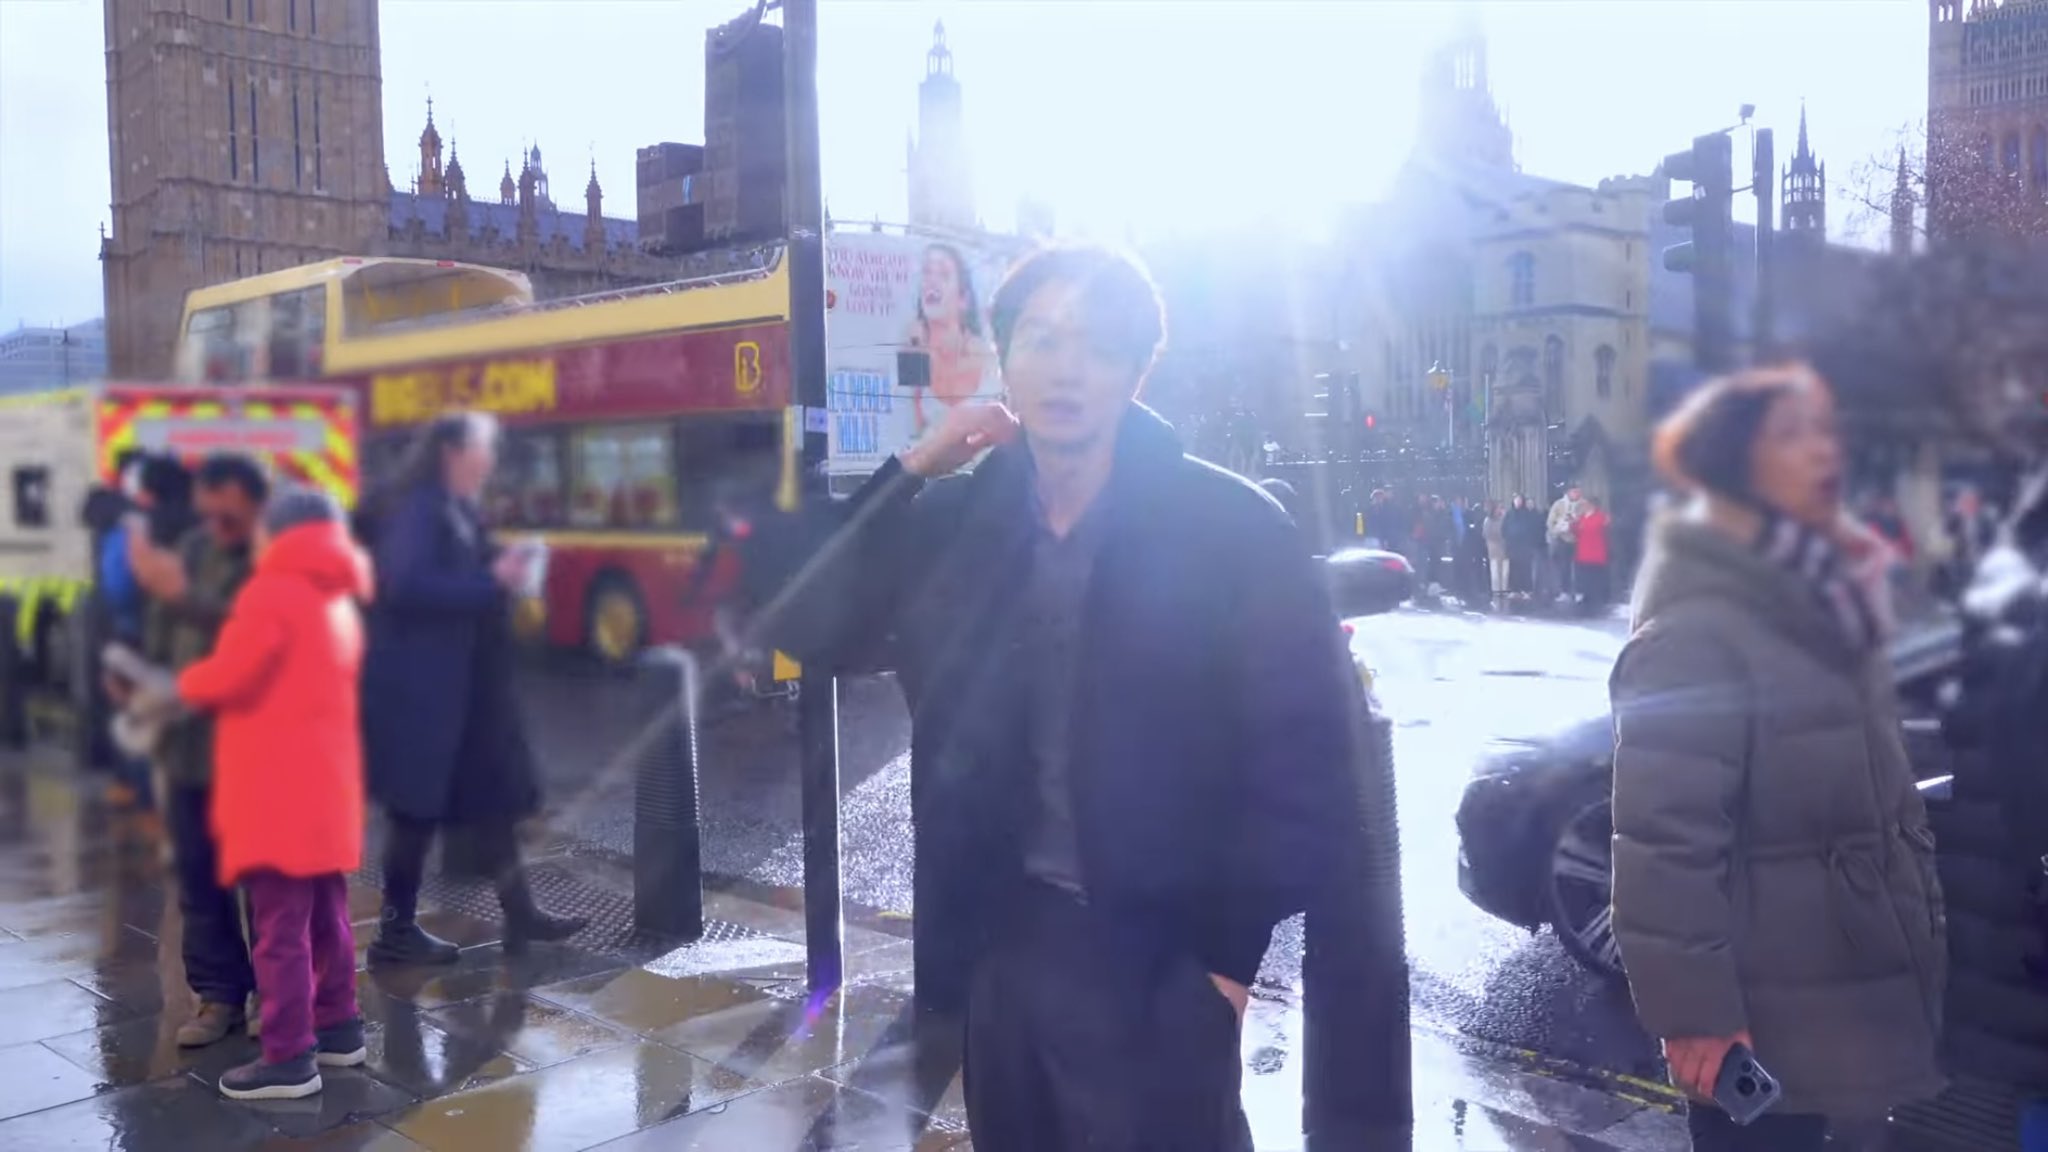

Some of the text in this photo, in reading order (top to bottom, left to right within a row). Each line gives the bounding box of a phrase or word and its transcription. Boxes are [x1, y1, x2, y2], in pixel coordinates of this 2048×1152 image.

[826, 246, 854, 263] YOU
[828, 263, 864, 281] KNOW
[845, 297, 875, 316] LOVE
[372, 360, 557, 424] BS.COM
